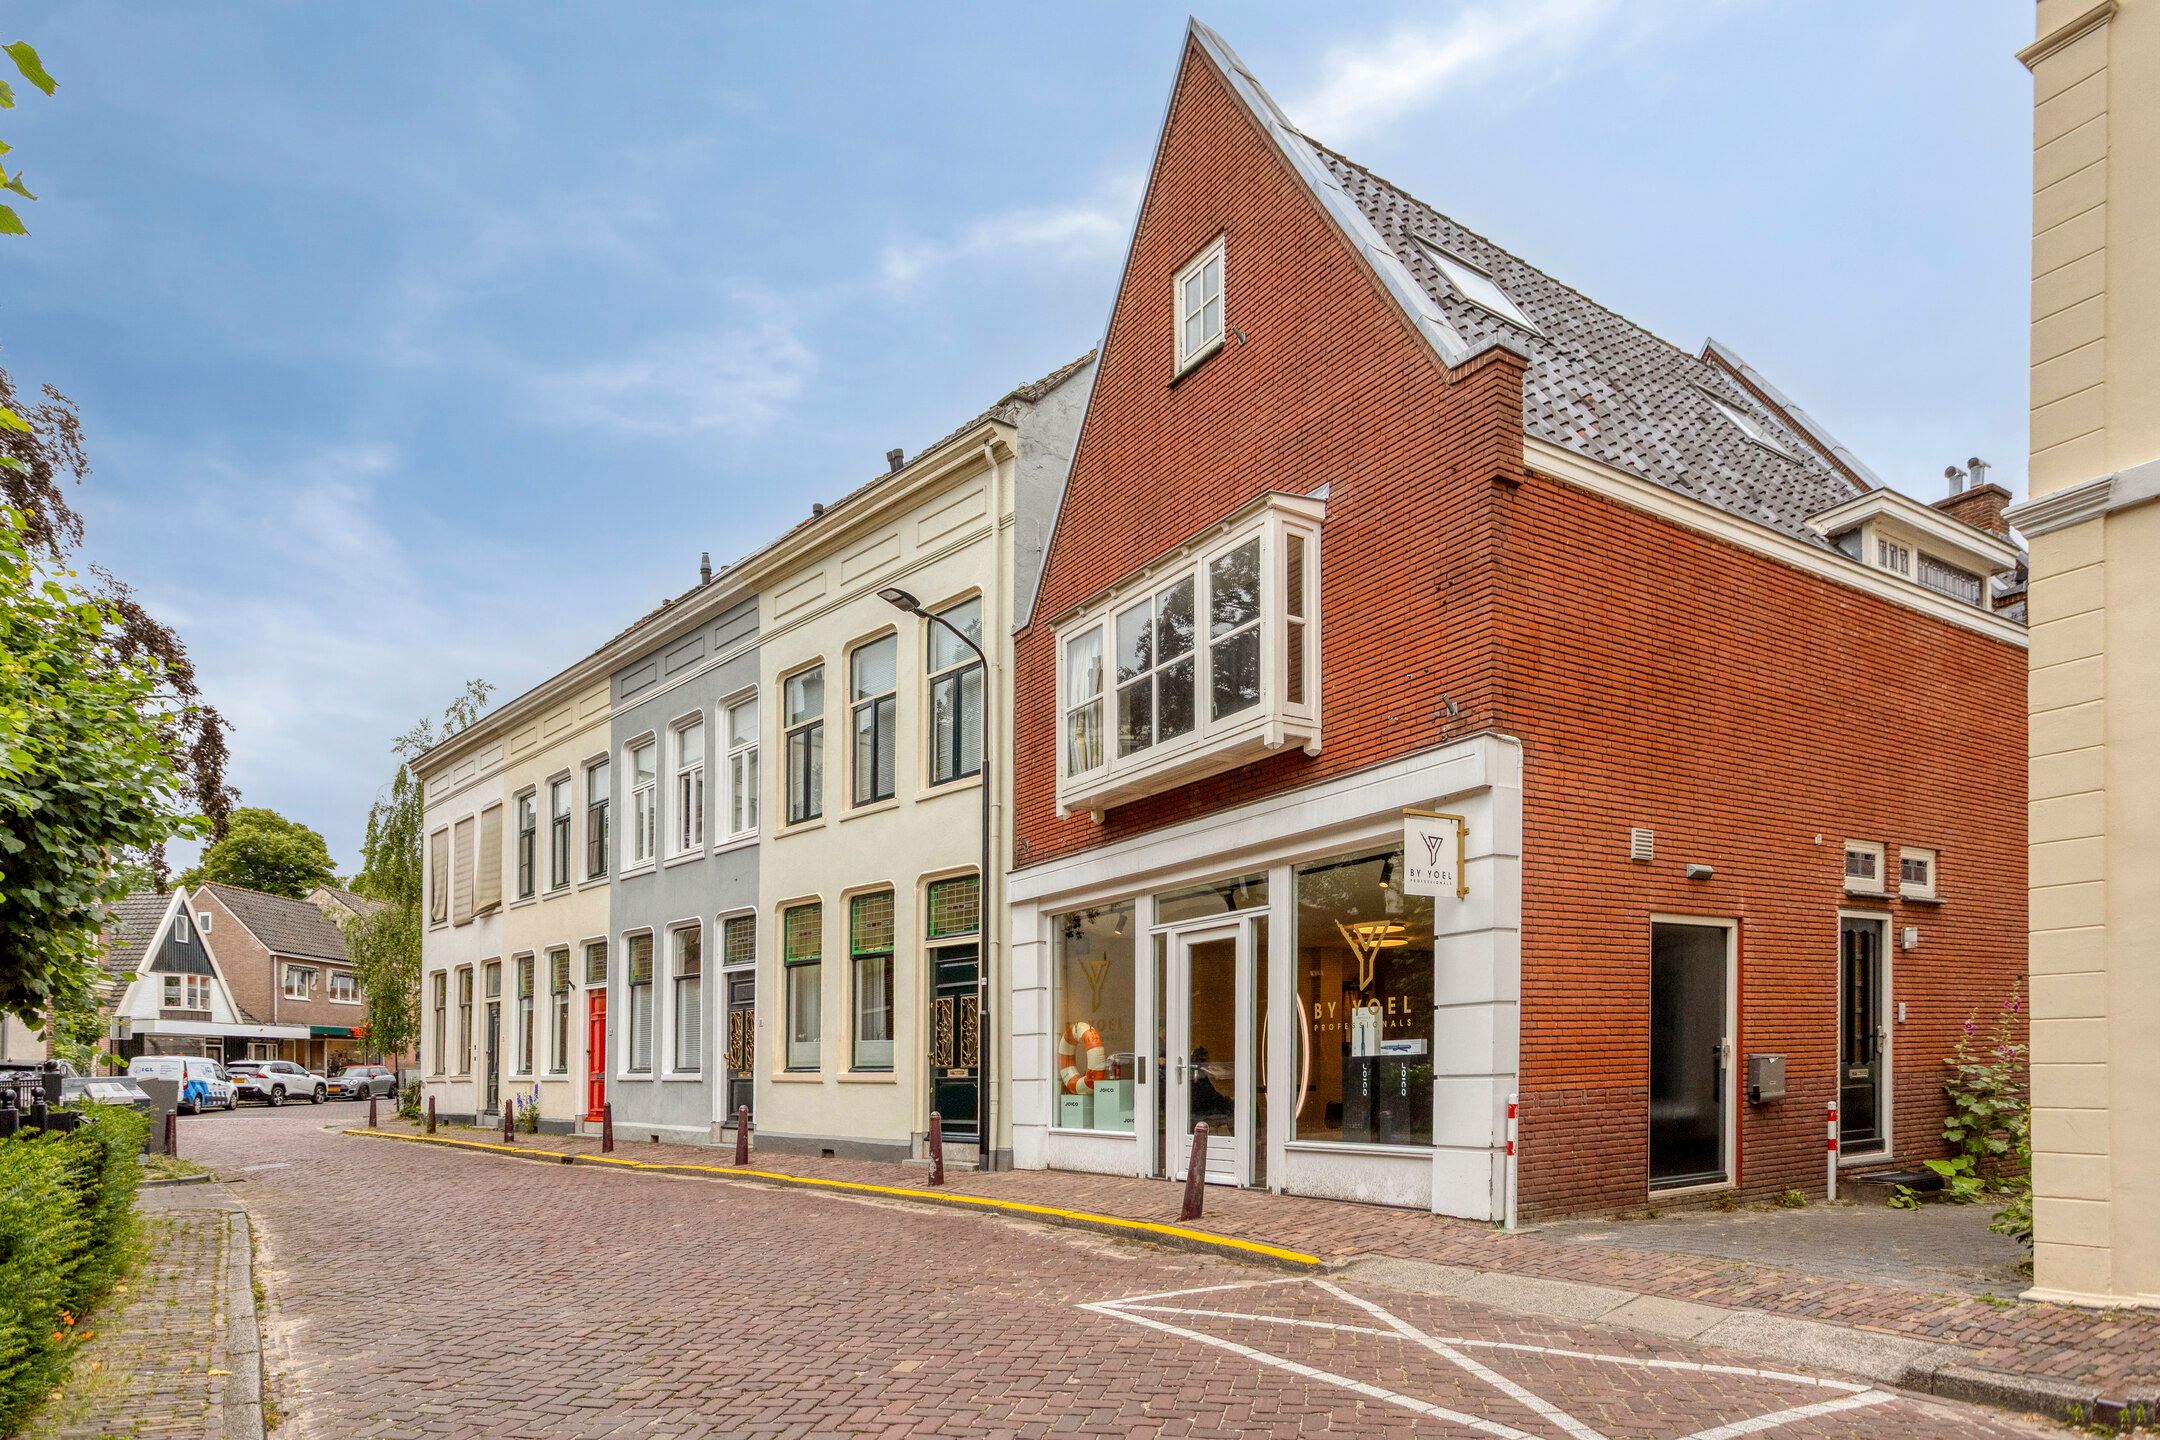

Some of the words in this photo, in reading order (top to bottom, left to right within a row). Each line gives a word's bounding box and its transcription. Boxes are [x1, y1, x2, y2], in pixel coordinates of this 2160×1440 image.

[1410, 868, 1421, 877] BY
[1427, 870, 1452, 880] YOEL
[1314, 1001, 1336, 1019] BY
[1352, 995, 1411, 1016] YOEL
[1314, 1018, 1412, 1031] PROFESSIONALS
